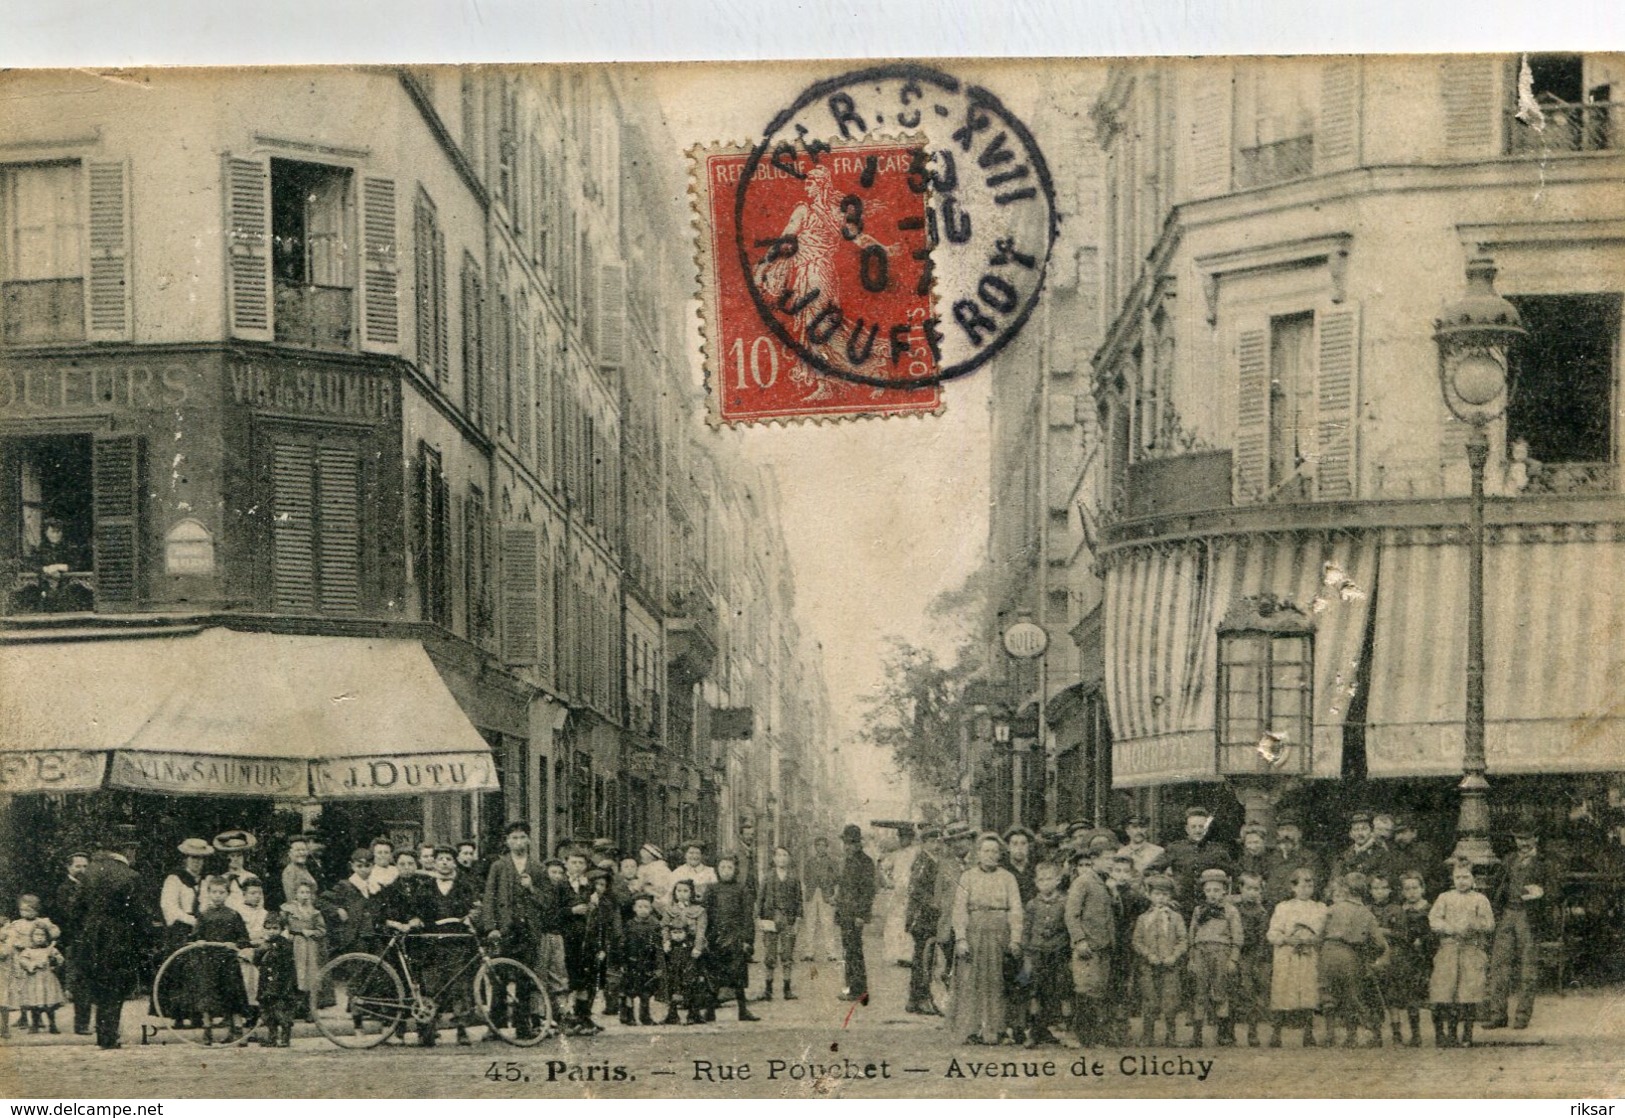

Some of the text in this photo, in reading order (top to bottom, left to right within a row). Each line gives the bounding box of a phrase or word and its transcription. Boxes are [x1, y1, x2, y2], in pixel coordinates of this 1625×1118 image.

[833, 153, 917, 176] FRAÇAIS
[728, 336, 779, 390] 10
[192, 760, 282, 786] SAUMUR
